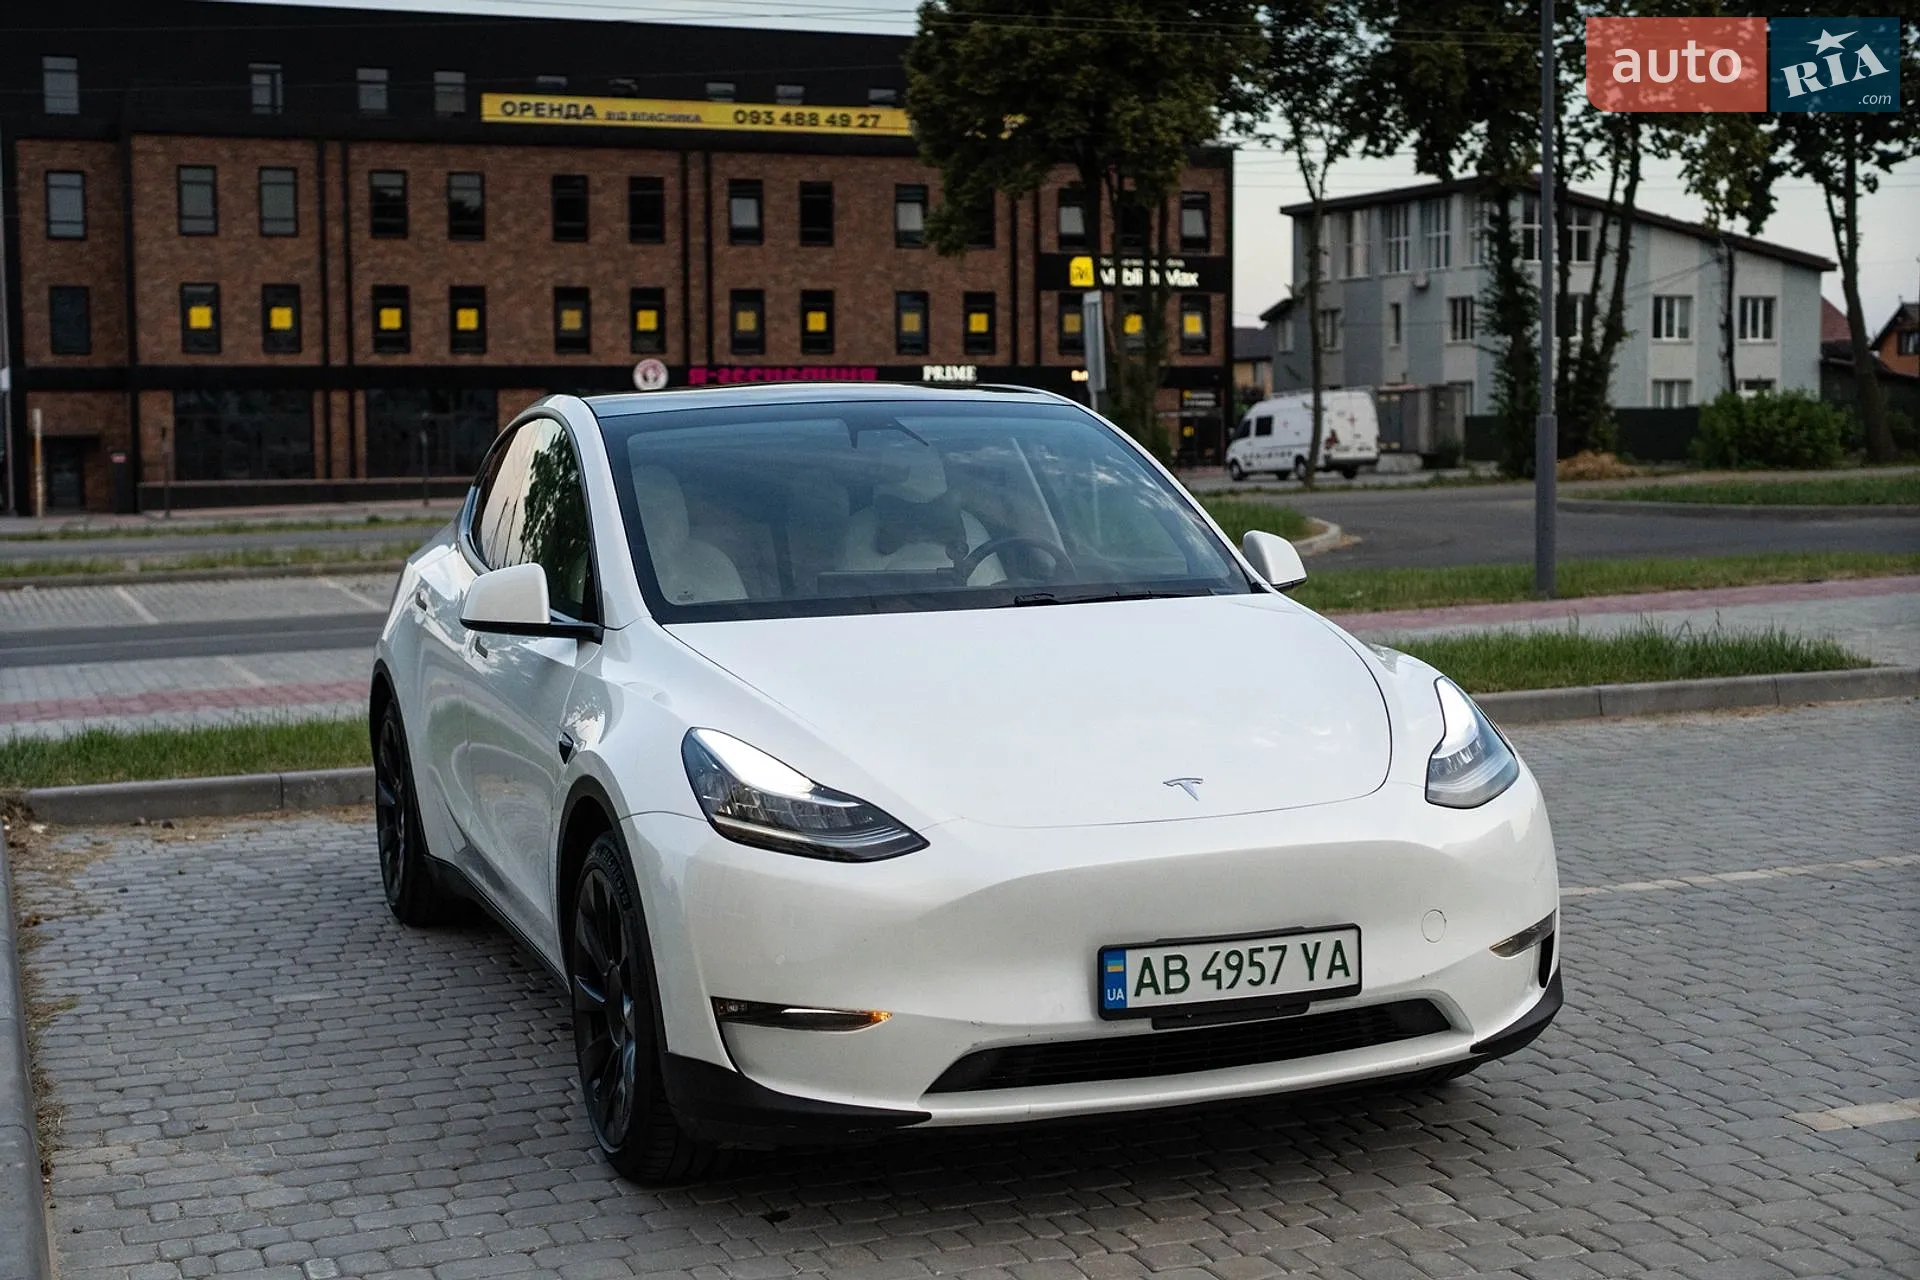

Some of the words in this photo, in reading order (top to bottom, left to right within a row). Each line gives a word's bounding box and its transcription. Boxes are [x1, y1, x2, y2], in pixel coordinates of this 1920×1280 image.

[501, 100, 597, 120] ОРЕНДА
[733, 109, 775, 125] 093
[780, 111, 819, 127] 488
[825, 112, 851, 128] 49
[856, 113, 881, 128] 27
[923, 365, 977, 381] PRIME
[1134, 954, 1190, 997] AB
[1201, 945, 1288, 990] 4957
[1301, 940, 1351, 981] YA
[1107, 988, 1124, 1001] UA
